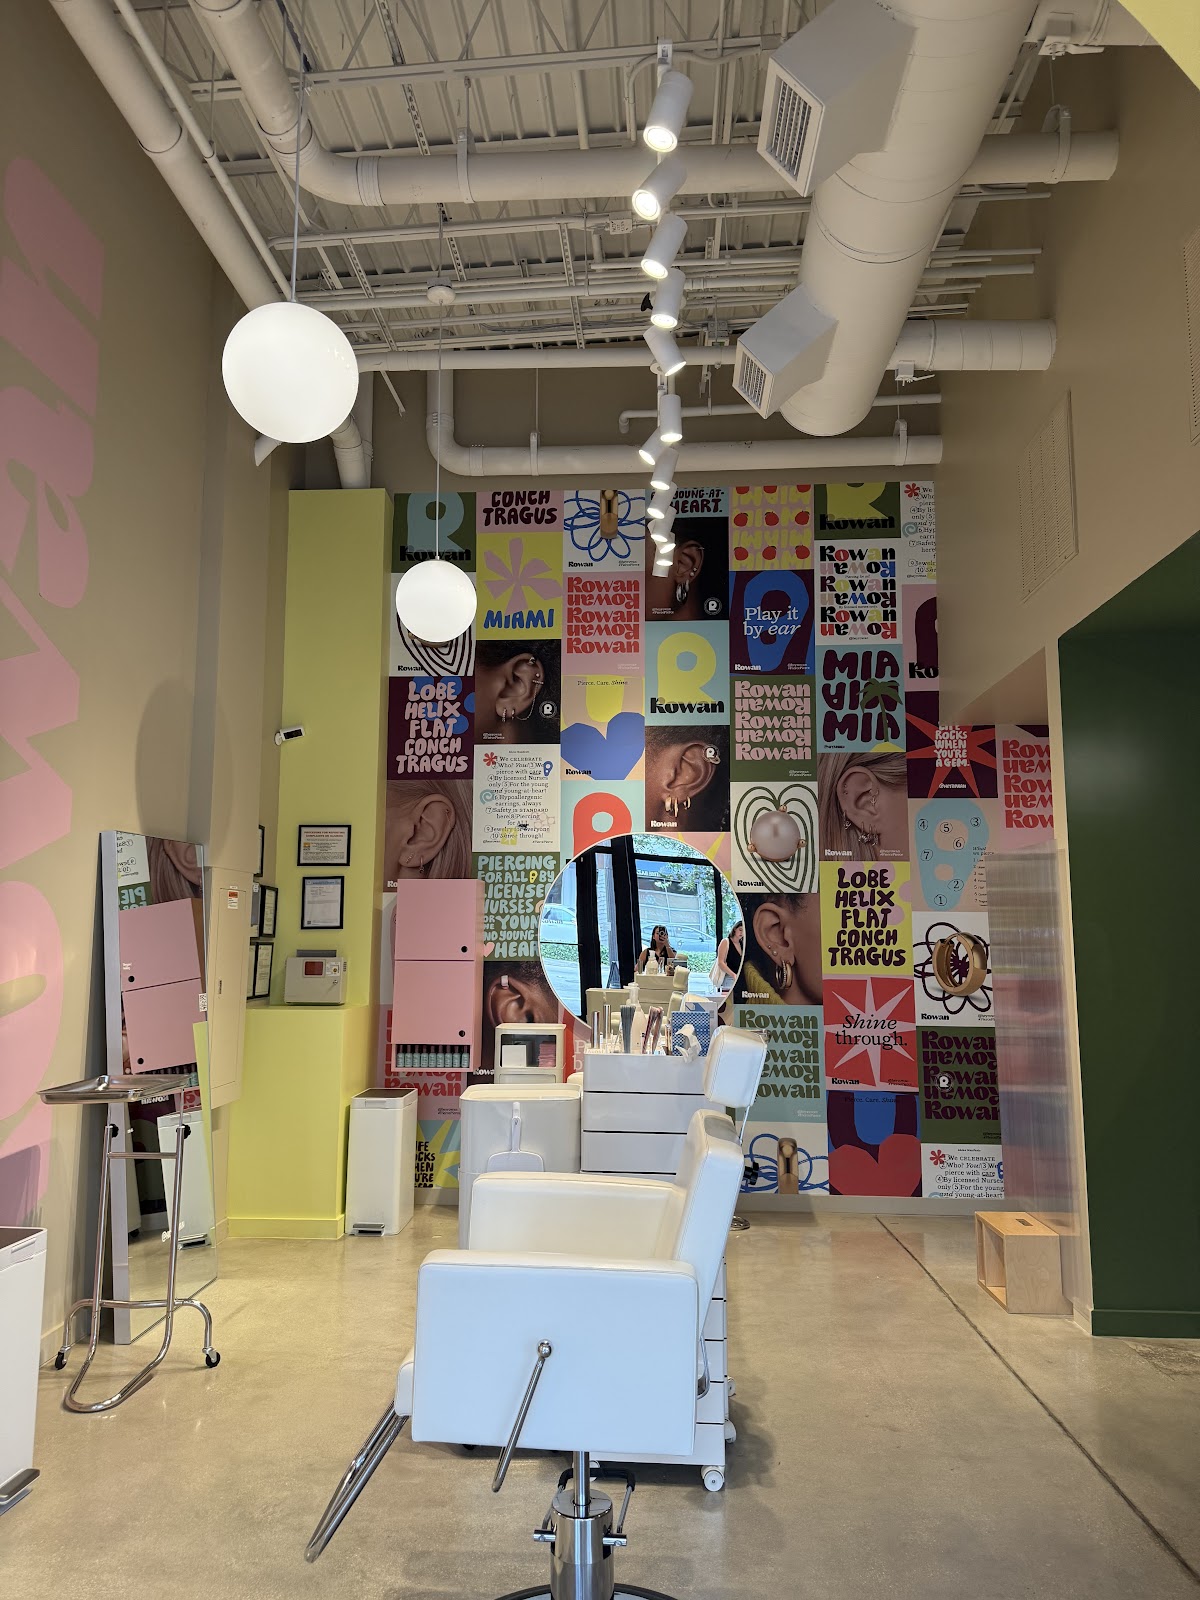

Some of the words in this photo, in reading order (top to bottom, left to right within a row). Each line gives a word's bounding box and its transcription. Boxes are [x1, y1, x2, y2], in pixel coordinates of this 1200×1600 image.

[491, 490, 550, 507] CONCH
[483, 507, 557, 526] TRAGUS
[820, 514, 895, 530] Rowan
[400, 545, 471, 562] Rowan
[820, 546, 896, 562] Rowan
[568, 560, 593, 568] Rowan
[566, 576, 640, 592] Rowan
[820, 576, 896, 592] Rowan
[484, 609, 554, 629] MIAMI
[566, 607, 640, 623] Rowan
[745, 607, 782, 624] Play
[786, 606, 798, 620] it
[820, 606, 896, 622] Rowan
[743, 622, 764, 639] by
[768, 623, 801, 636] ear
[566, 637, 640, 654] Rowan
[822, 650, 900, 680] MIA
[408, 680, 458, 701] LOBE
[734, 680, 810, 698] Rowan
[405, 700, 460, 720] HELIX
[650, 698, 724, 714] Rowan
[410, 718, 457, 738] FLAT
[735, 712, 811, 728] Rowan
[822, 711, 900, 742] MIA
[936, 730, 968, 740] ROCKS
[404, 738, 462, 756] CONCH
[736, 743, 812, 760] Rowan
[934, 740, 966, 750] WHEN
[1002, 740, 1050, 758] Row
[934, 750, 967, 759] YOU'RE
[396, 754, 468, 774] TRAGUS
[936, 758, 942, 768] A
[943, 758, 970, 768] GEM.
[1004, 774, 1052, 793] Row
[650, 820, 677, 828] Rowan
[1005, 810, 1054, 828] Row
[478, 855, 556, 870] PIERCING
[478, 871, 502, 883] FOR
[504, 872, 528, 883] ALL
[539, 870, 555, 882] BY
[838, 868, 890, 888] LOBE
[485, 884, 552, 898] ICENSE
[834, 889, 894, 908] HELIX
[496, 914, 540, 930] YOUN
[842, 908, 892, 928] FLAT
[485, 931, 498, 940] ND
[836, 930, 898, 948] CONCH
[494, 942, 540, 958] HEAR
[828, 947, 906, 967] TRAGUS
[742, 990, 770, 998] Rowan
[740, 1010, 818, 1030] Rowan
[842, 1014, 897, 1030] Shine
[769, 1030, 818, 1048] Row
[835, 1030, 908, 1050] through.
[473, 1068, 494, 1076] Rowa
[756, 1083, 820, 1098] owan
[416, 1141, 430, 1152] IFE
[416, 1152, 436, 1162] CKS
[416, 1162, 434, 1172] HEN
[415, 1173, 434, 1182] U'RE
